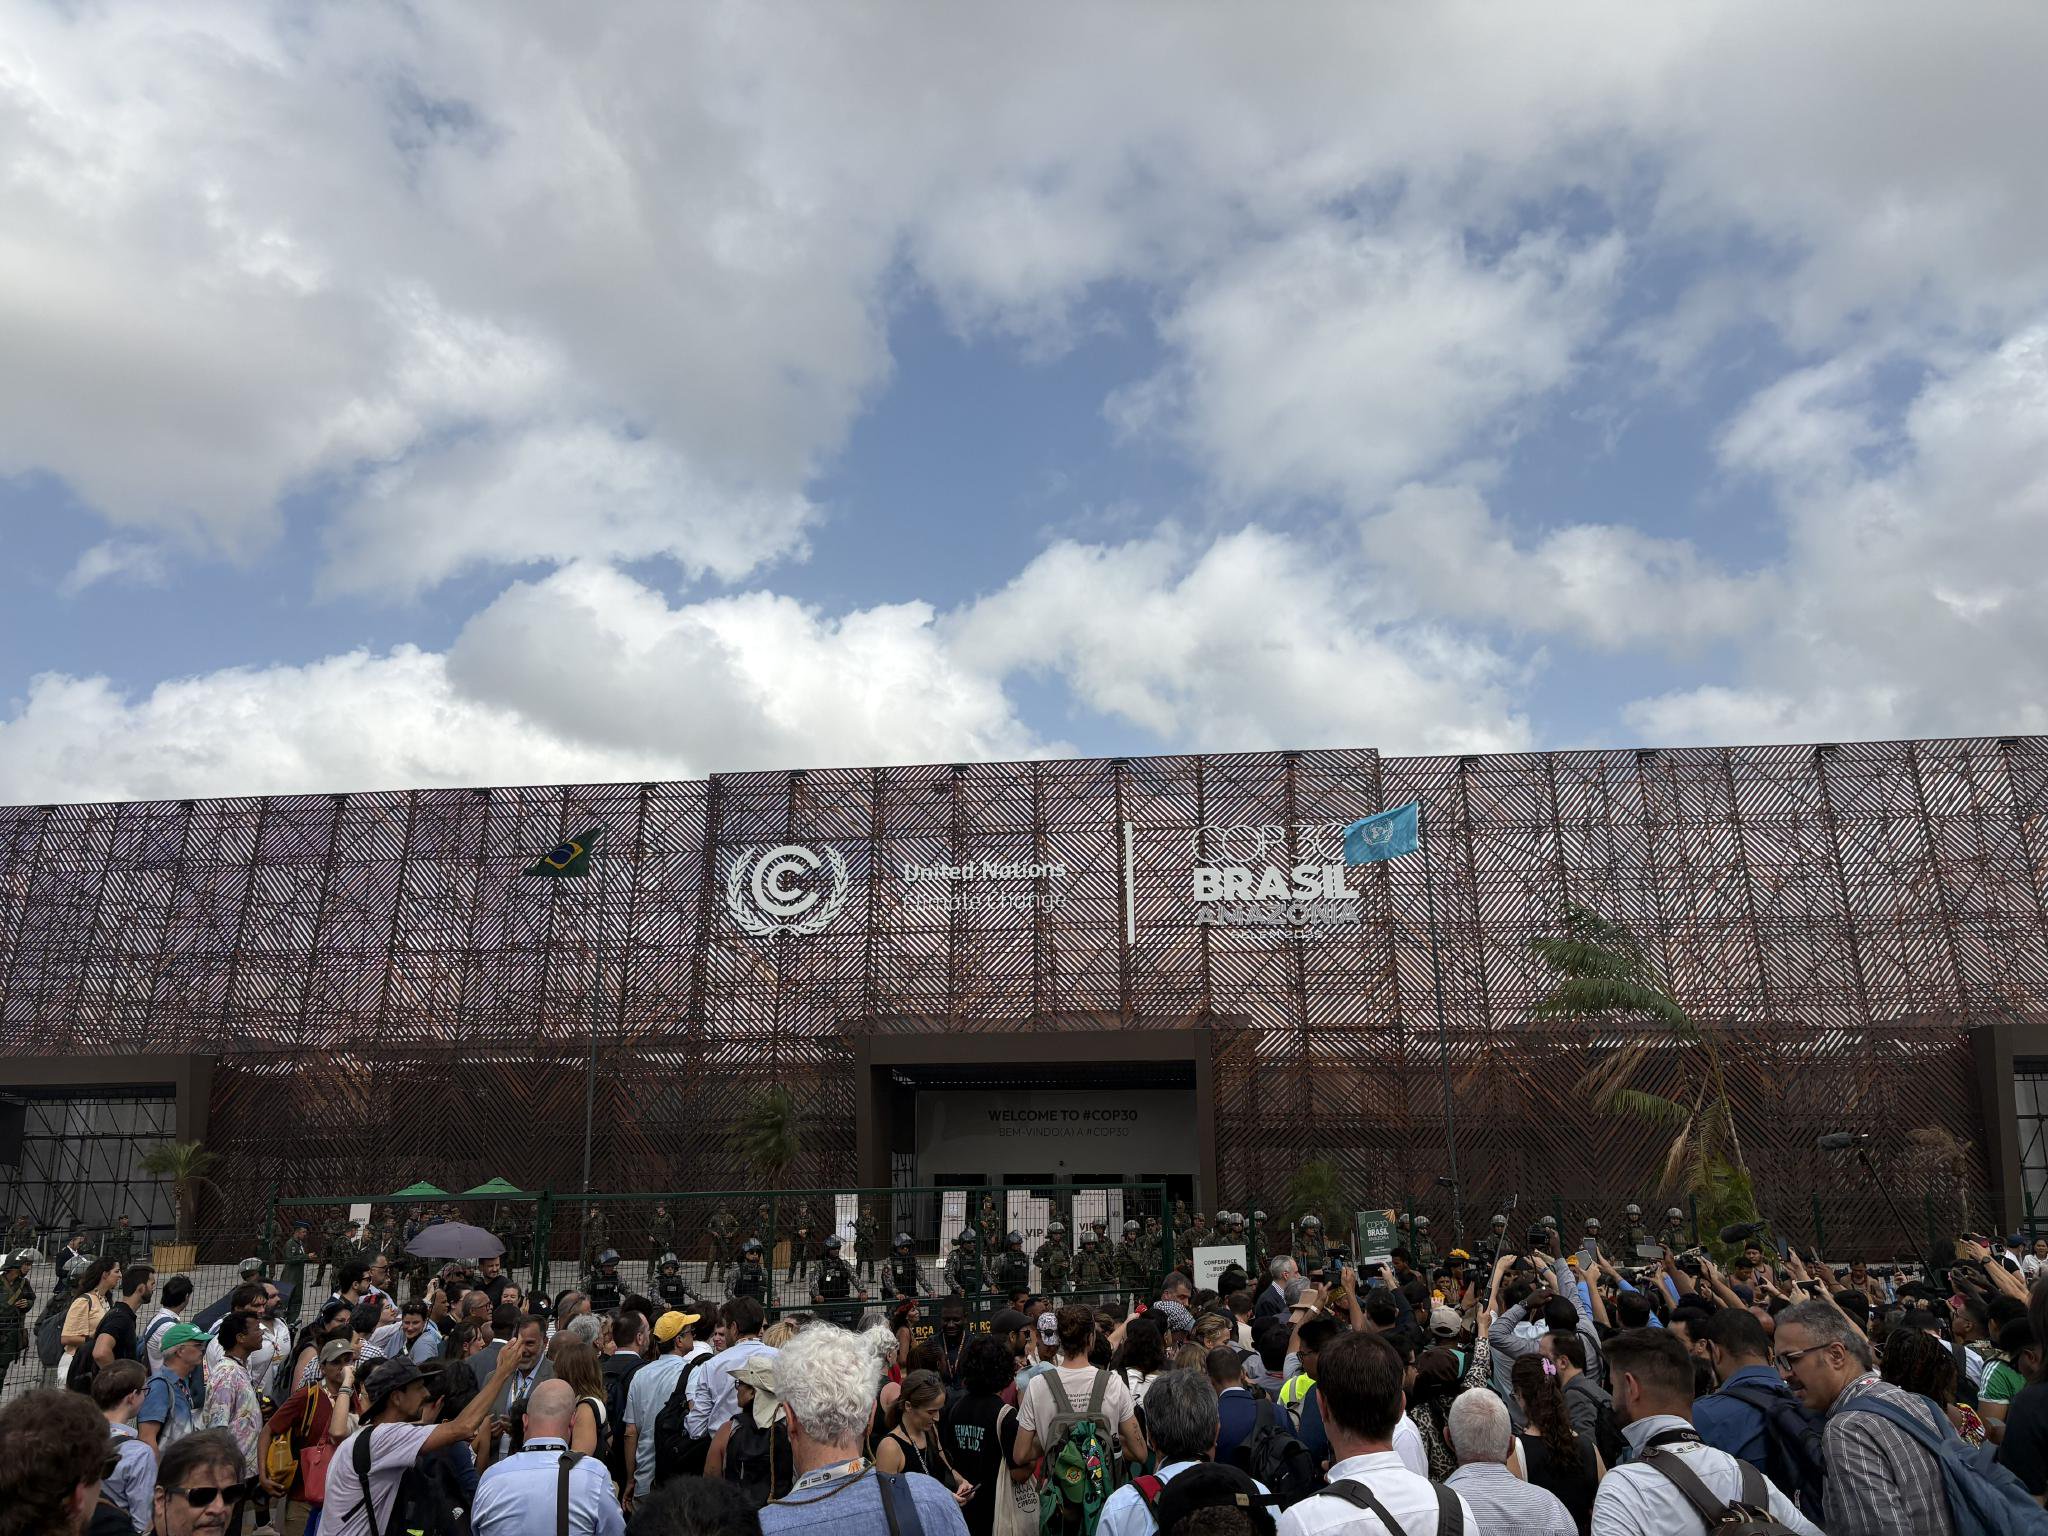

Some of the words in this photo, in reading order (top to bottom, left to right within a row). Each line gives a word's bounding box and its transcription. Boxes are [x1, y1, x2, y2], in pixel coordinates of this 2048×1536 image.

[904, 860, 974, 881] United
[982, 860, 1067, 879] Nations
[1193, 865, 1360, 901] BRASIL
[903, 891, 980, 912] Climate
[988, 891, 1066, 913] Change
[1196, 899, 1360, 926] AMAZÔNIA
[1284, 929, 1323, 939] 2025
[988, 1110, 1057, 1121] WELCOME
[1060, 1110, 1079, 1121] TO
[1083, 1110, 1138, 1121] #COP30
[999, 1127, 1074, 1137] BEM-VINDO(A)
[1077, 1128, 1083, 1137] A
[1086, 1128, 1130, 1137] #COP30
[1367, 1220, 1388, 1229] COP30
[1026, 1228, 1043, 1238] VIP
[1367, 1228, 1389, 1236] BRASIL
[1203, 1258, 1237, 1266] CONFERENCE
